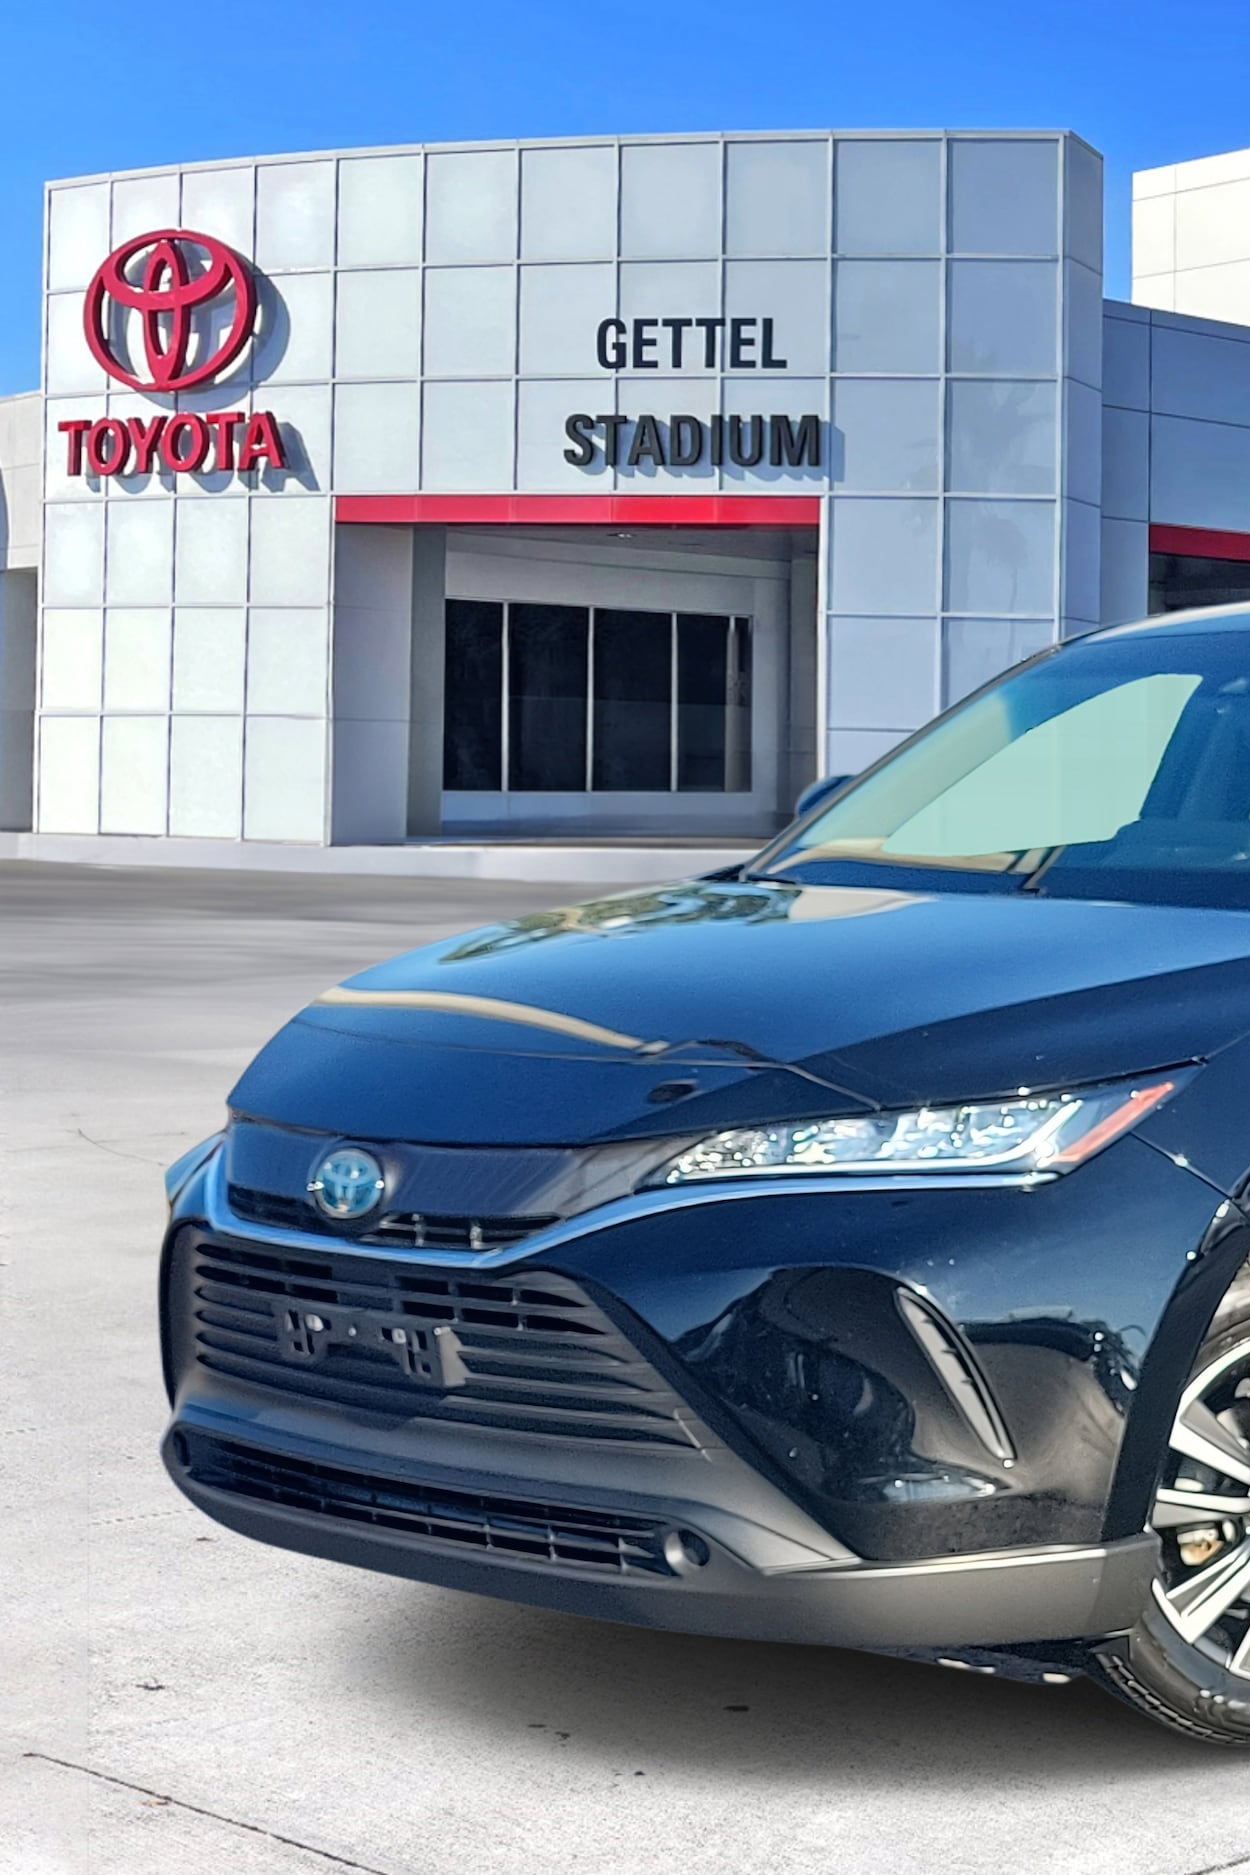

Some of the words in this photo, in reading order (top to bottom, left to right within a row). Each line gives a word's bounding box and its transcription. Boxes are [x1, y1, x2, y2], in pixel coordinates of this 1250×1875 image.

[597, 318, 787, 369] GETTEL
[58, 412, 285, 475] TOYOTA
[564, 414, 821, 467] STADIUM
